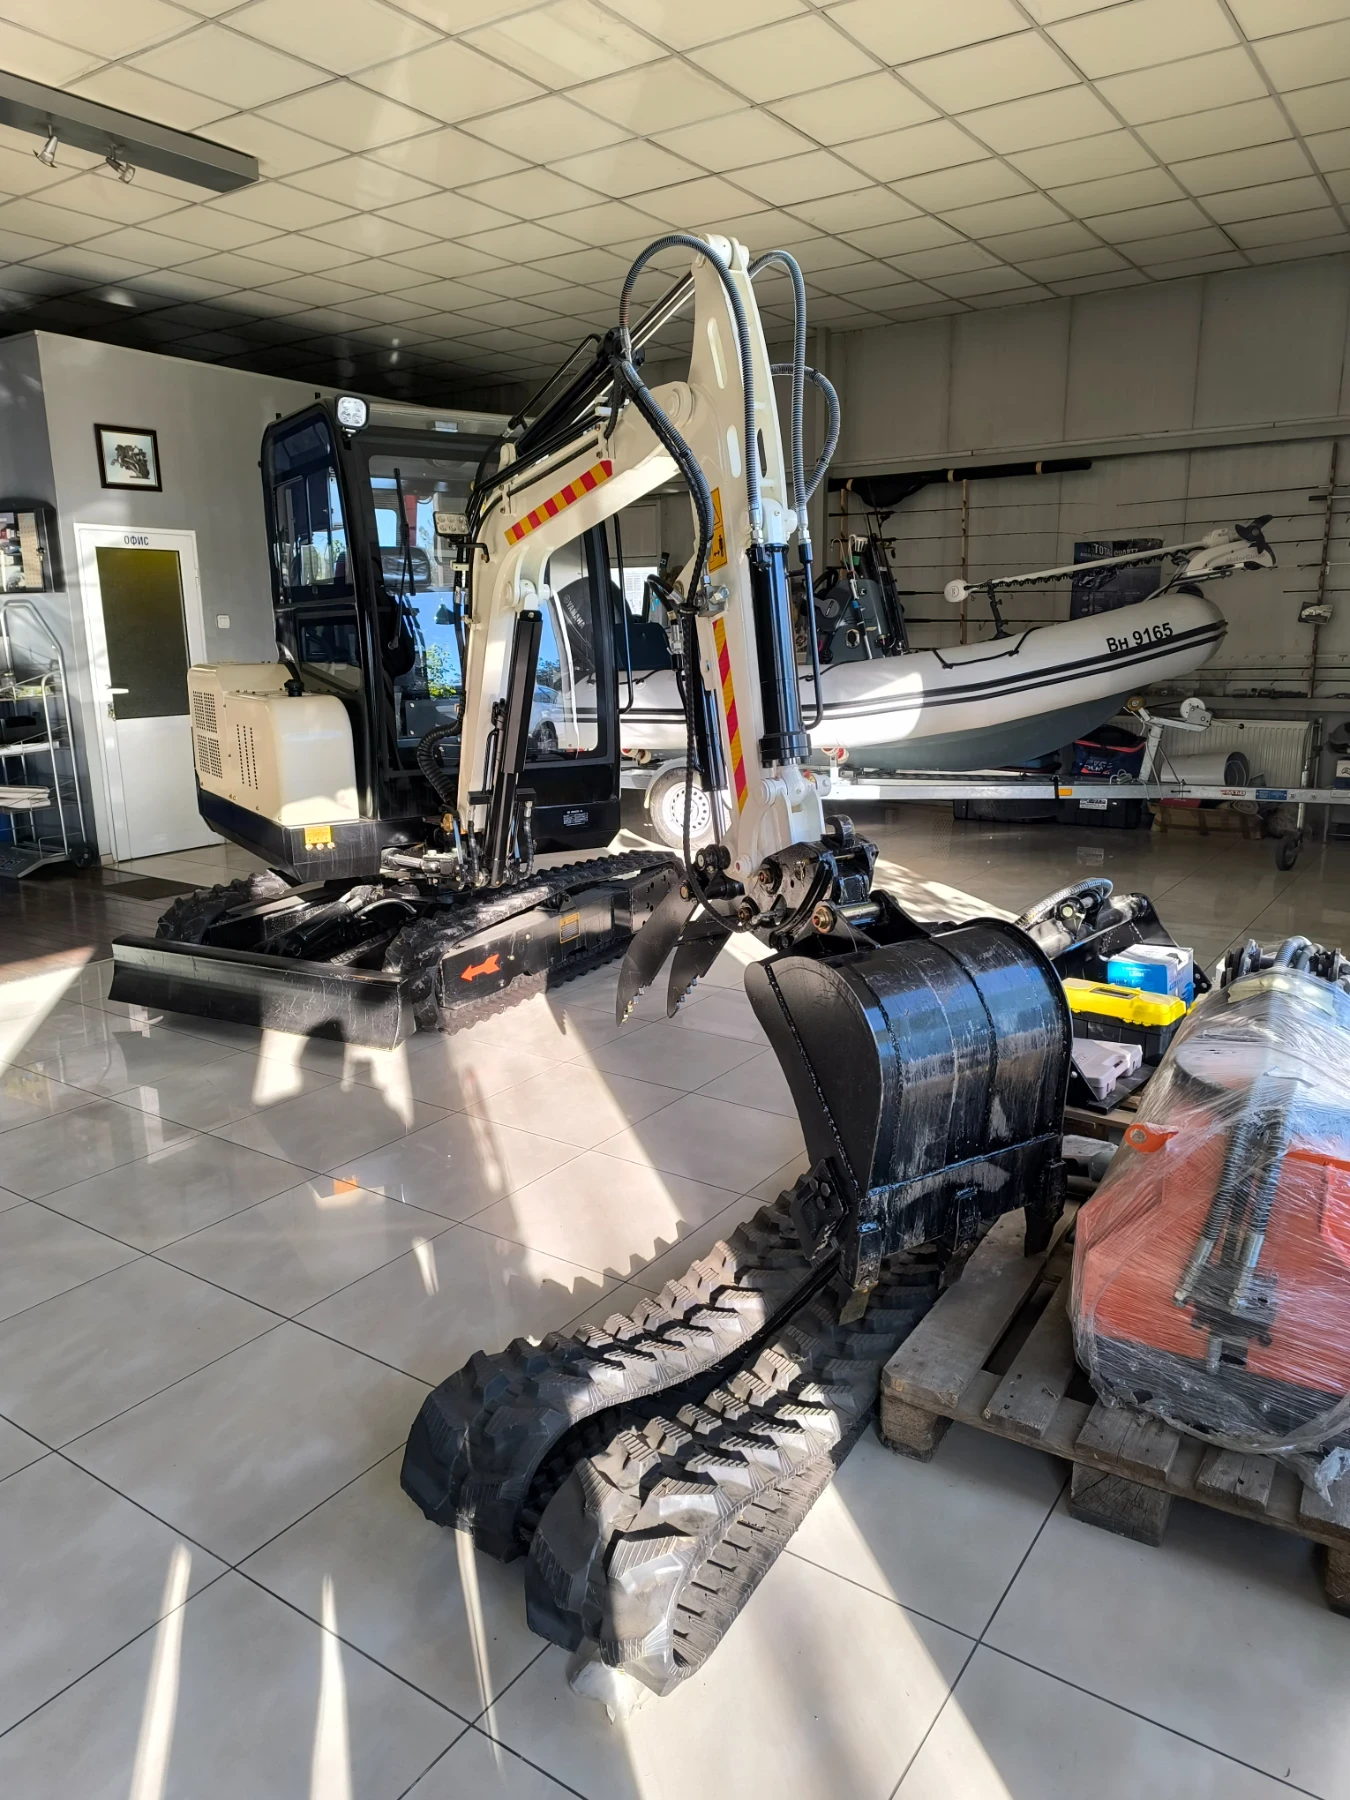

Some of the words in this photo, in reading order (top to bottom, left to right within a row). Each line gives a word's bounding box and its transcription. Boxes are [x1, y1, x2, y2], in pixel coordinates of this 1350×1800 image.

[124, 535, 149, 546] ОФИС
[1093, 543, 1113, 557] TOTAL
[566, 601, 585, 629] YAMAHA
[1132, 622, 1173, 646] 9165
